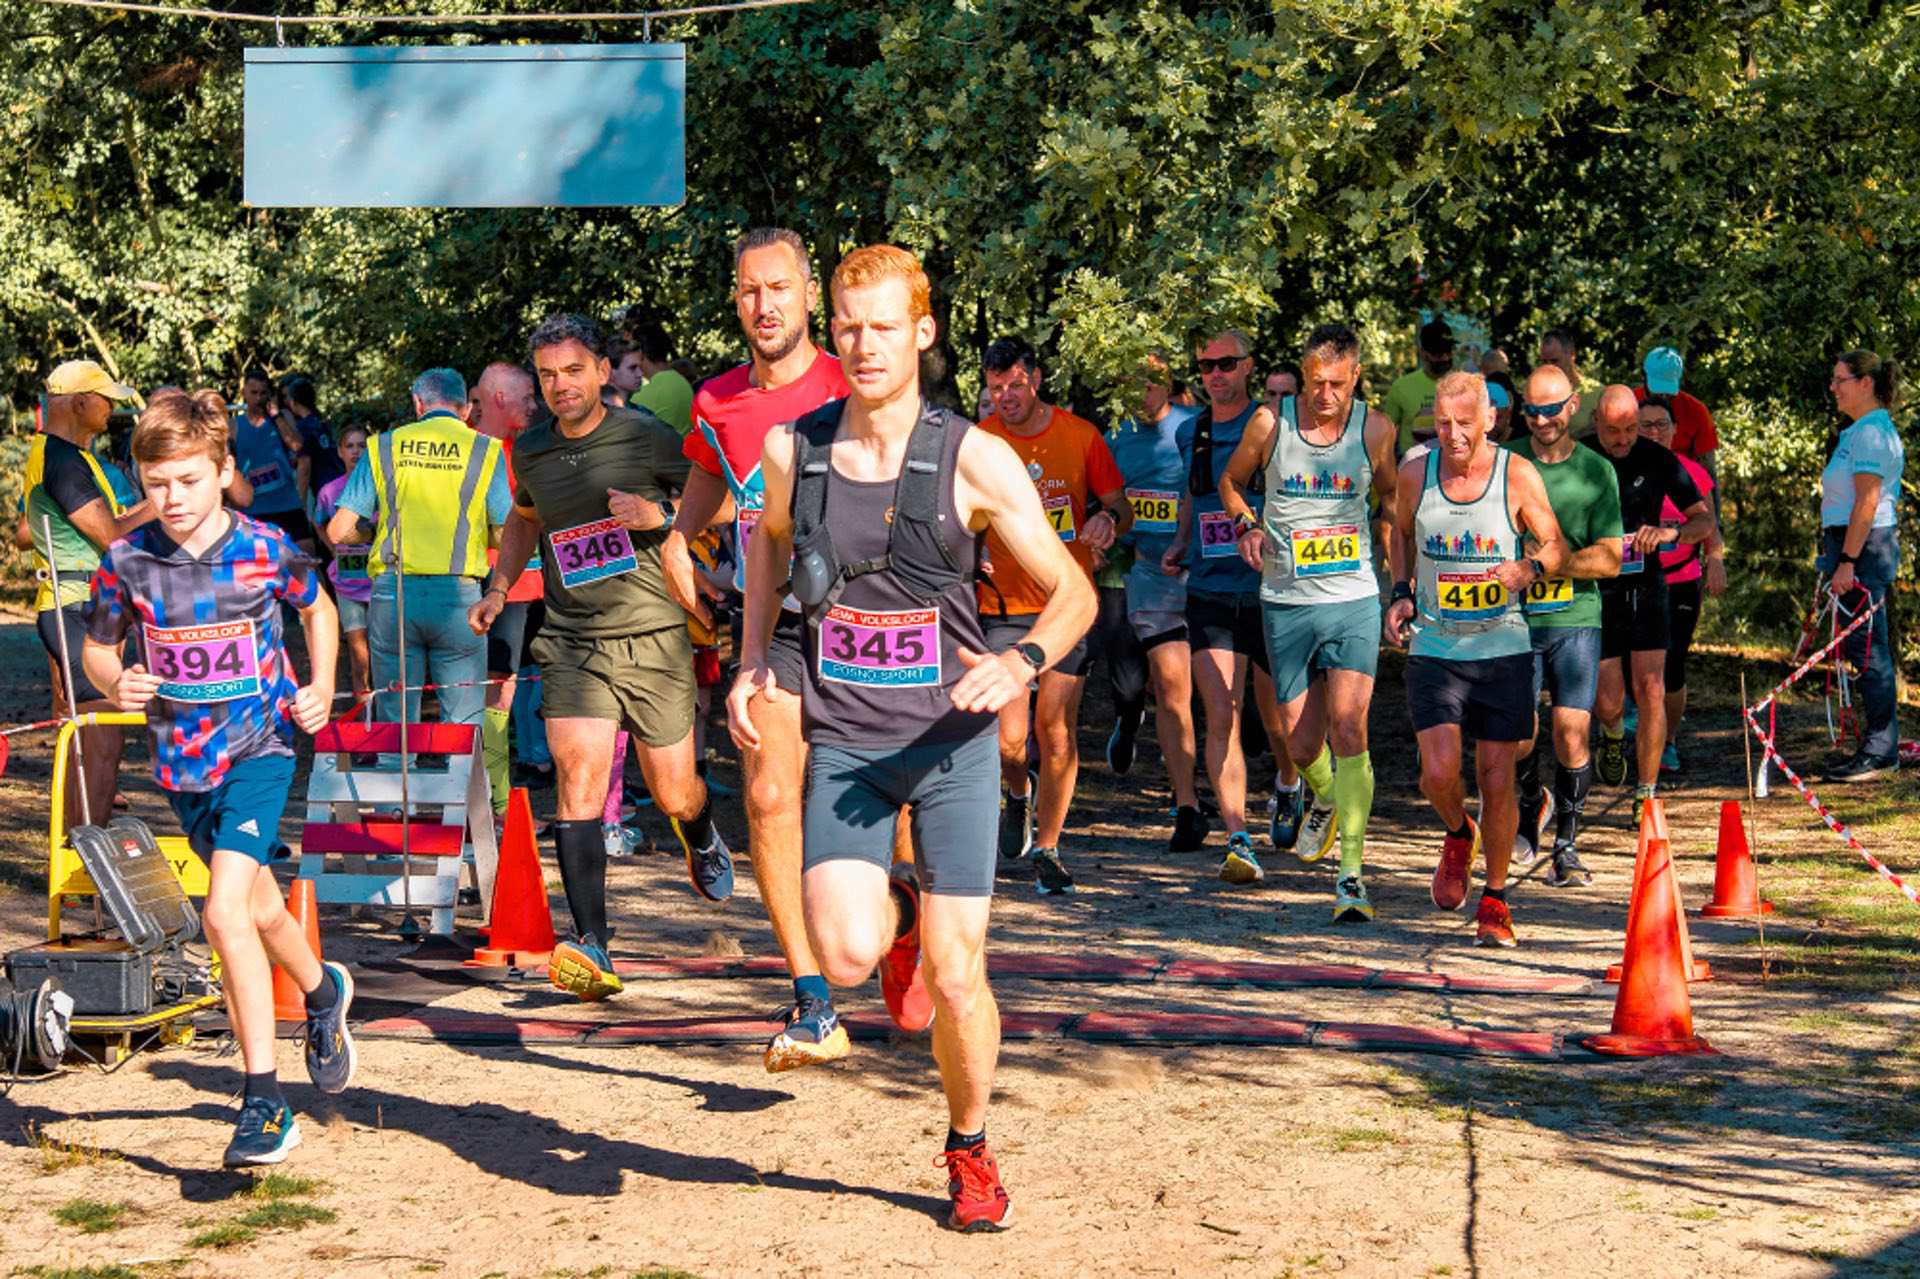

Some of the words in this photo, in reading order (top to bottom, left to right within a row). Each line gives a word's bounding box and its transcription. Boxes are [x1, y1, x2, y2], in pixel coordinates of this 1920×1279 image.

[400, 440, 460, 457] HEMA
[1050, 509, 1065, 531] 7
[1133, 499, 1170, 519] 408
[1205, 522, 1233, 544] 33
[563, 533, 624, 568] 346
[1301, 537, 1353, 561] 446
[1445, 584, 1501, 607] 410
[1530, 579, 1565, 600] 07
[860, 612, 932, 625] VOLKSLOOP
[831, 626, 924, 664] 345
[155, 642, 244, 680] 394
[881, 668, 925, 681] SPORT
[169, 860, 188, 876] Y
